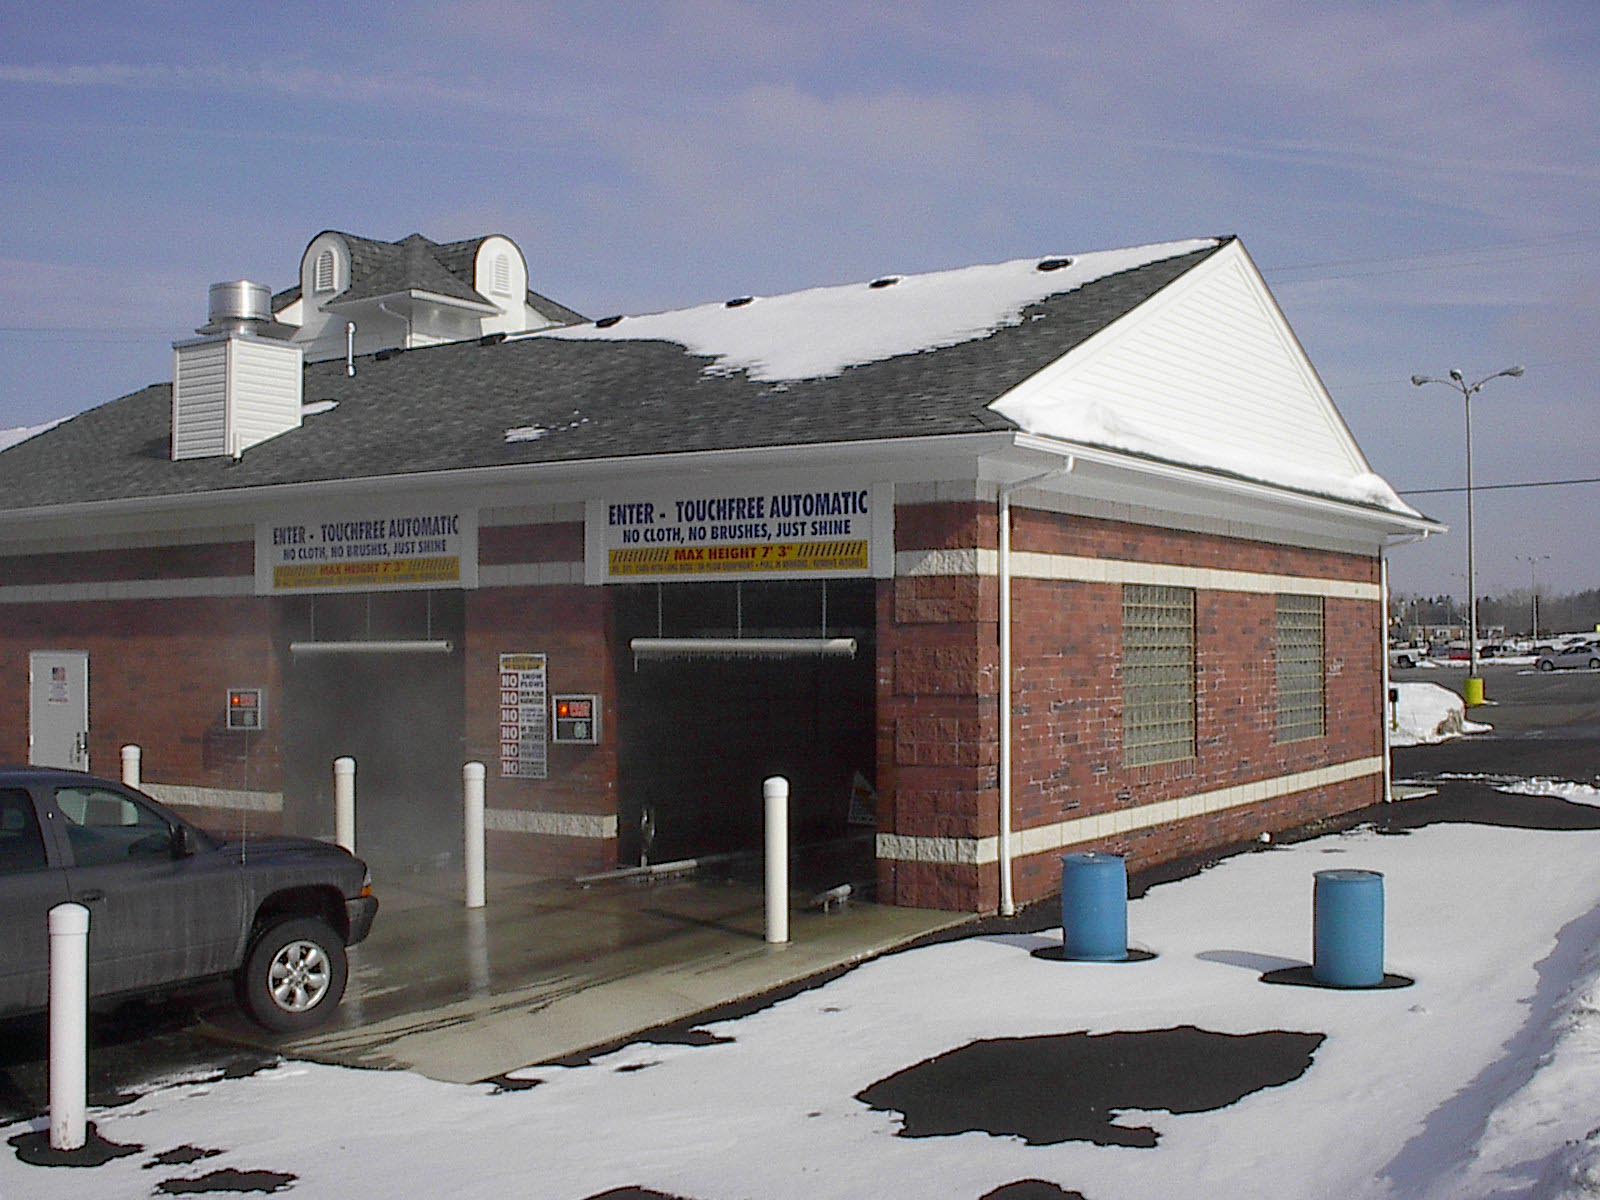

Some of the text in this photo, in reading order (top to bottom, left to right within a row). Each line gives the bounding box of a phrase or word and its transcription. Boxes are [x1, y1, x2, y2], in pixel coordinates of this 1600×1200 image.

[608, 502, 654, 526] ENTER
[675, 497, 764, 523] TOUCHFREE
[769, 490, 868, 519] AUTOMATIC
[273, 526, 306, 545] ENTER
[321, 520, 385, 543] TOUCHFREE
[389, 515, 459, 538] AUTOMATIC
[623, 519, 851, 544] NO CLOTH, NO BRUSHES, JUST SHINE
[283, 539, 446, 561] NO CLOTH, NO BRUSHES, JUST SHINE
[674, 548, 704, 561] MAX
[708, 546, 758, 560] HEIGHT
[502, 675, 518, 687] NO
[502, 691, 518, 705] NO
[502, 708, 518, 722] NO
[502, 726, 518, 739] NO
[502, 743, 518, 756] NO
[502, 761, 518, 774] NO
